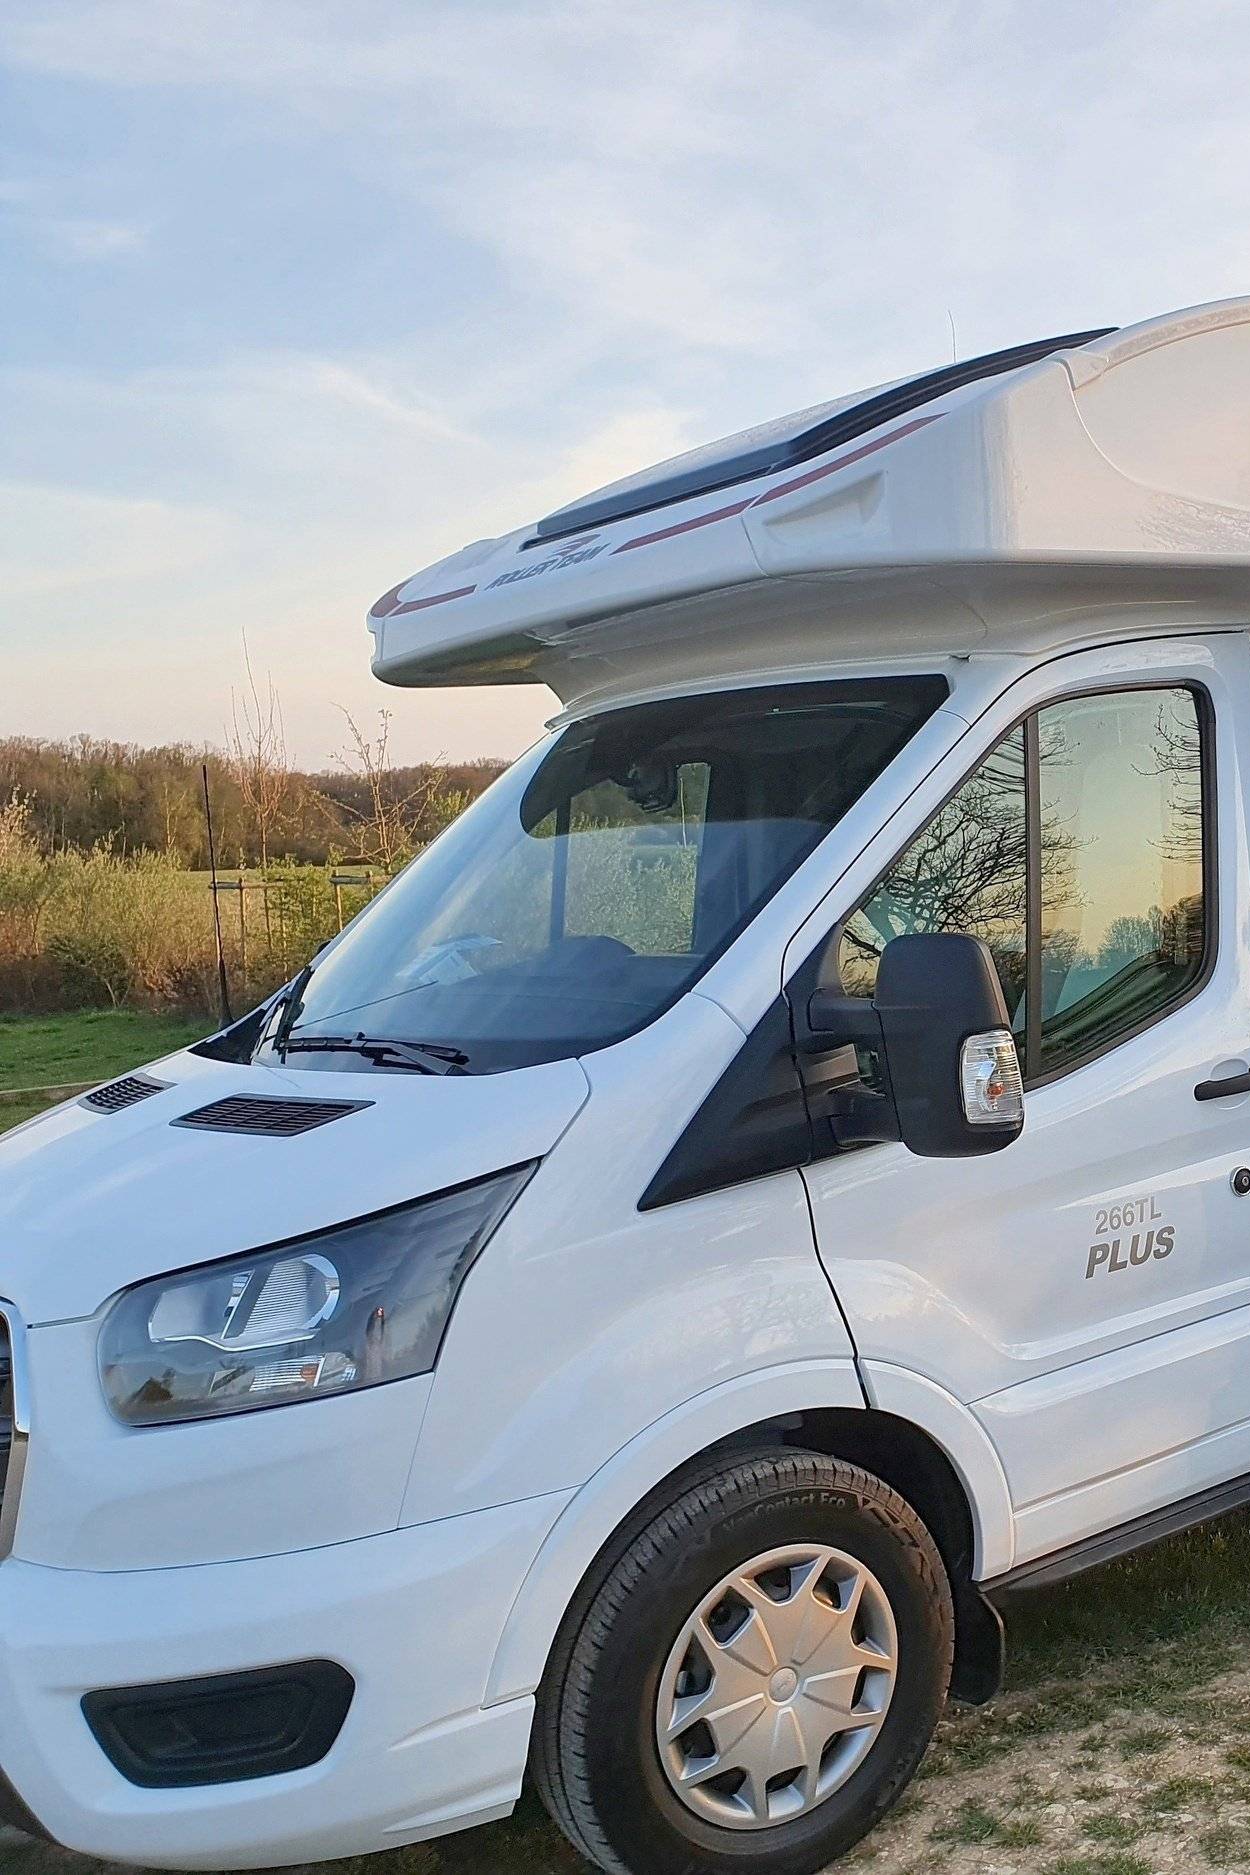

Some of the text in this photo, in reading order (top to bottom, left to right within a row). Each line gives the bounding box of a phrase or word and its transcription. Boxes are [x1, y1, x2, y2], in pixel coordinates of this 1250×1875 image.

[484, 543, 611, 591] ROLLER TEAM
[1095, 1196, 1162, 1235] 266TL
[1085, 1225, 1175, 1279] PLUS
